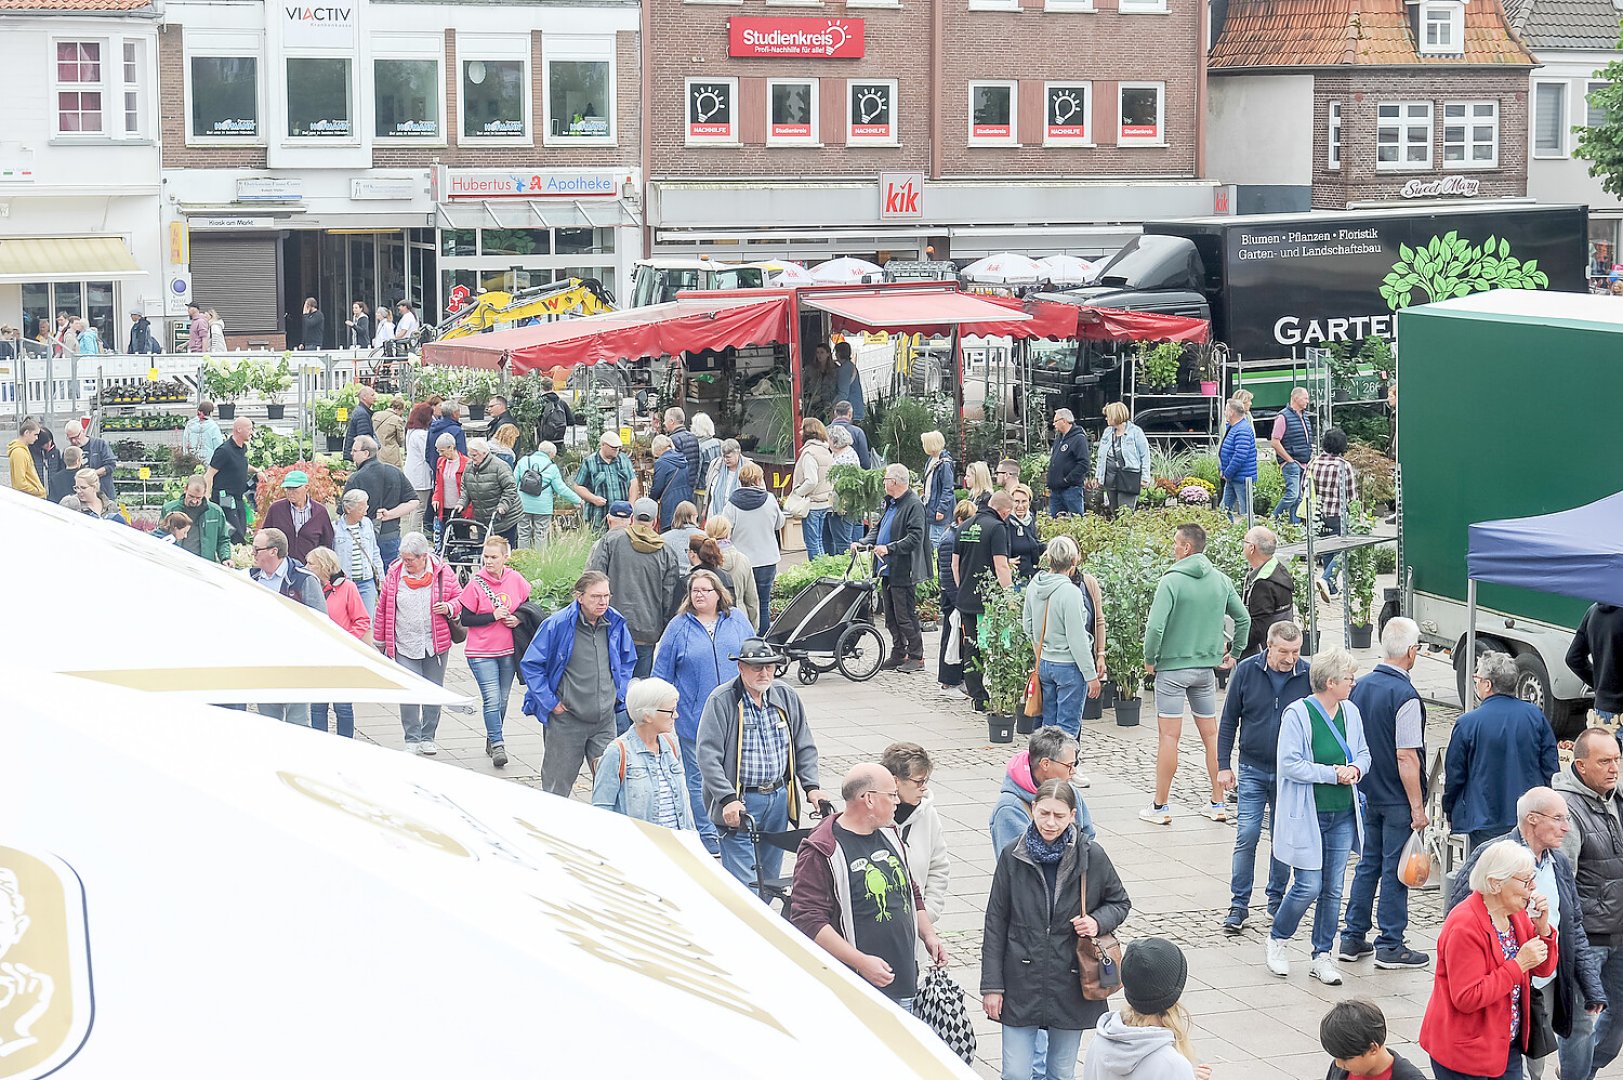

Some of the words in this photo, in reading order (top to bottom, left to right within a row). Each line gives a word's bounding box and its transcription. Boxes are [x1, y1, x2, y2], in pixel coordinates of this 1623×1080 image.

[285, 7, 351, 21] VIACTIV
[743, 29, 833, 45] Studienkreis
[452, 177, 512, 191] Hubertus
[547, 175, 611, 192] Apotheke
[885, 176, 919, 212] kik
[1241, 234, 1280, 245] Blumen
[1288, 232, 1331, 242] Pflanzen
[1339, 228, 1379, 240] Floristik
[1238, 249, 1278, 260] Garten-
[1280, 246, 1300, 258] und
[1302, 243, 1382, 256] Landschaftsbau
